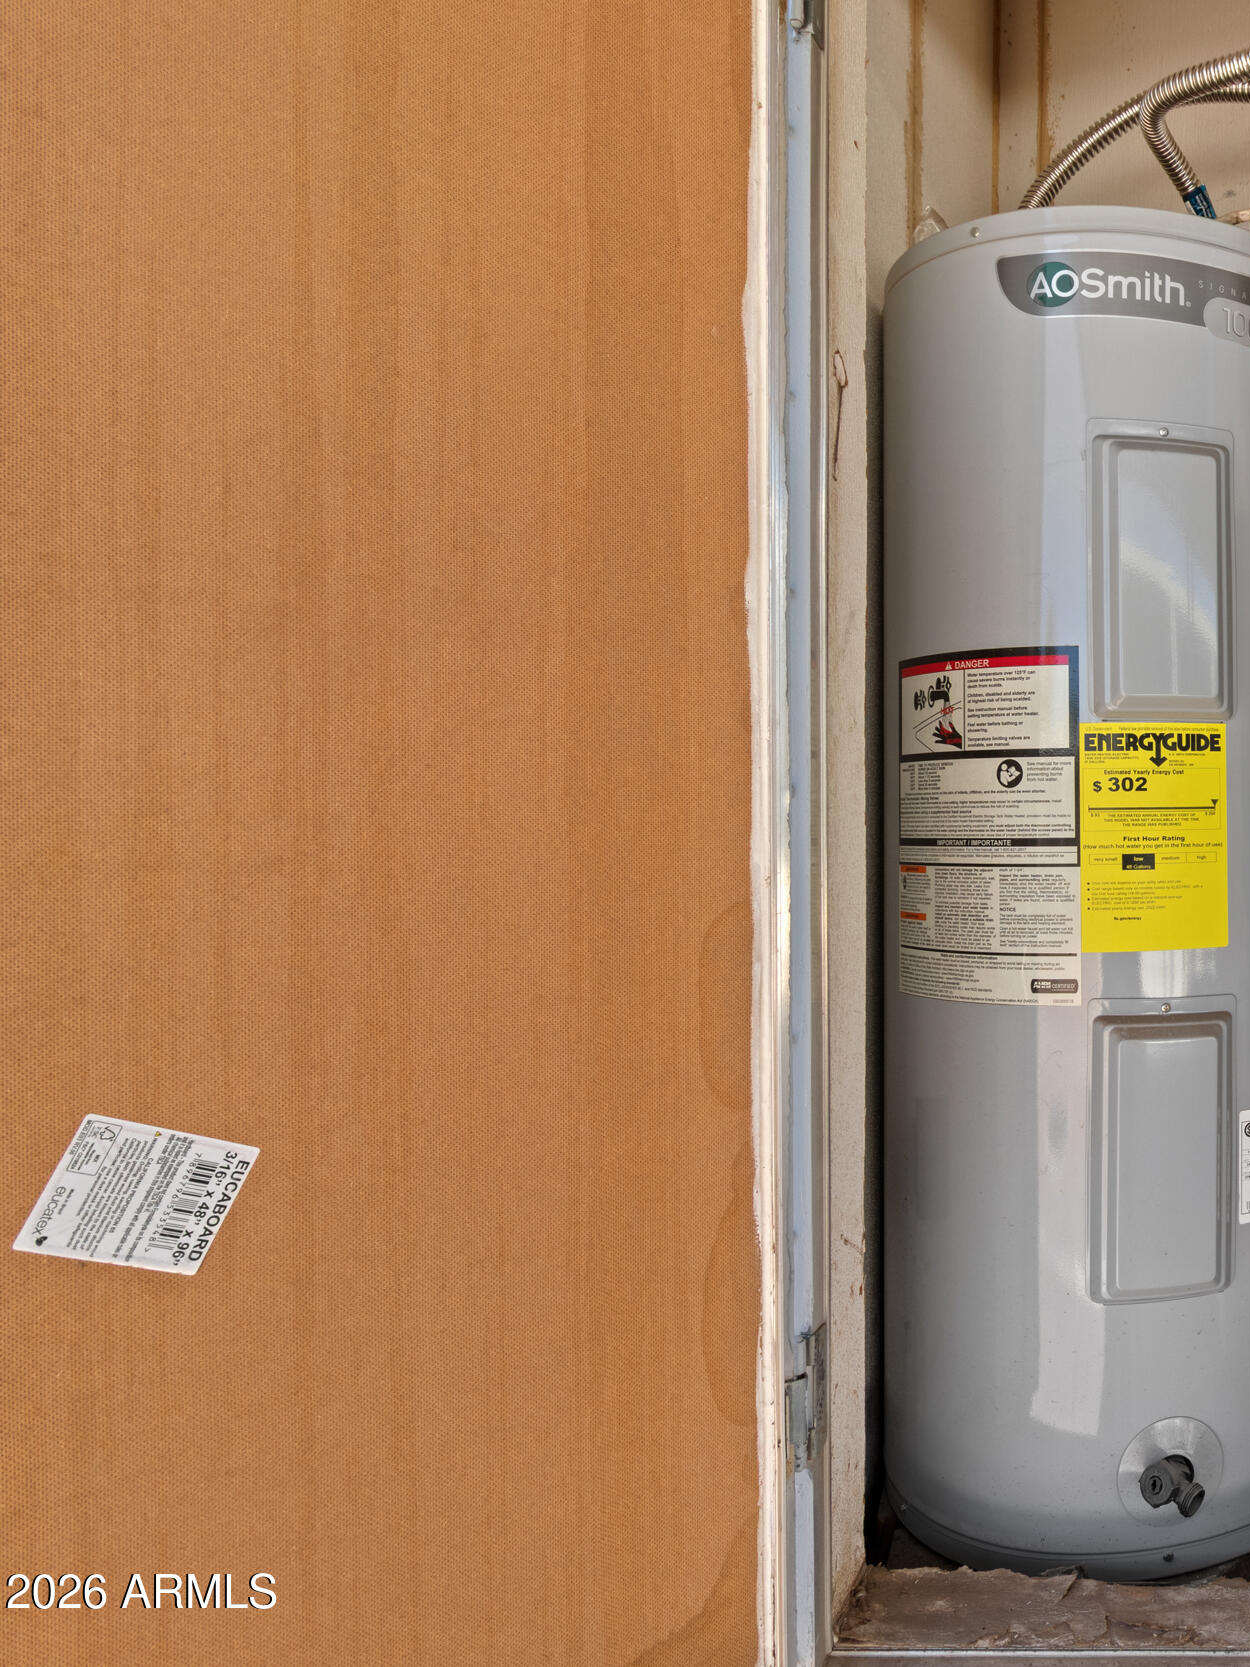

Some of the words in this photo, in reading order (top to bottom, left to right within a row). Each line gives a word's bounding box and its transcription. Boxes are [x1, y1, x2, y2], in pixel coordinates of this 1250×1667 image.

[954, 659, 989, 670] DANGER
[1084, 733, 1222, 752] ENERGYGUIDE
[1093, 780, 1102, 793] $
[1108, 776, 1148, 792] 302
[204, 1190, 215, 1198] x
[32, 1186, 67, 1236] eucatex
[188, 1160, 250, 1262] EUCABOARD
[183, 1229, 194, 1238] x
